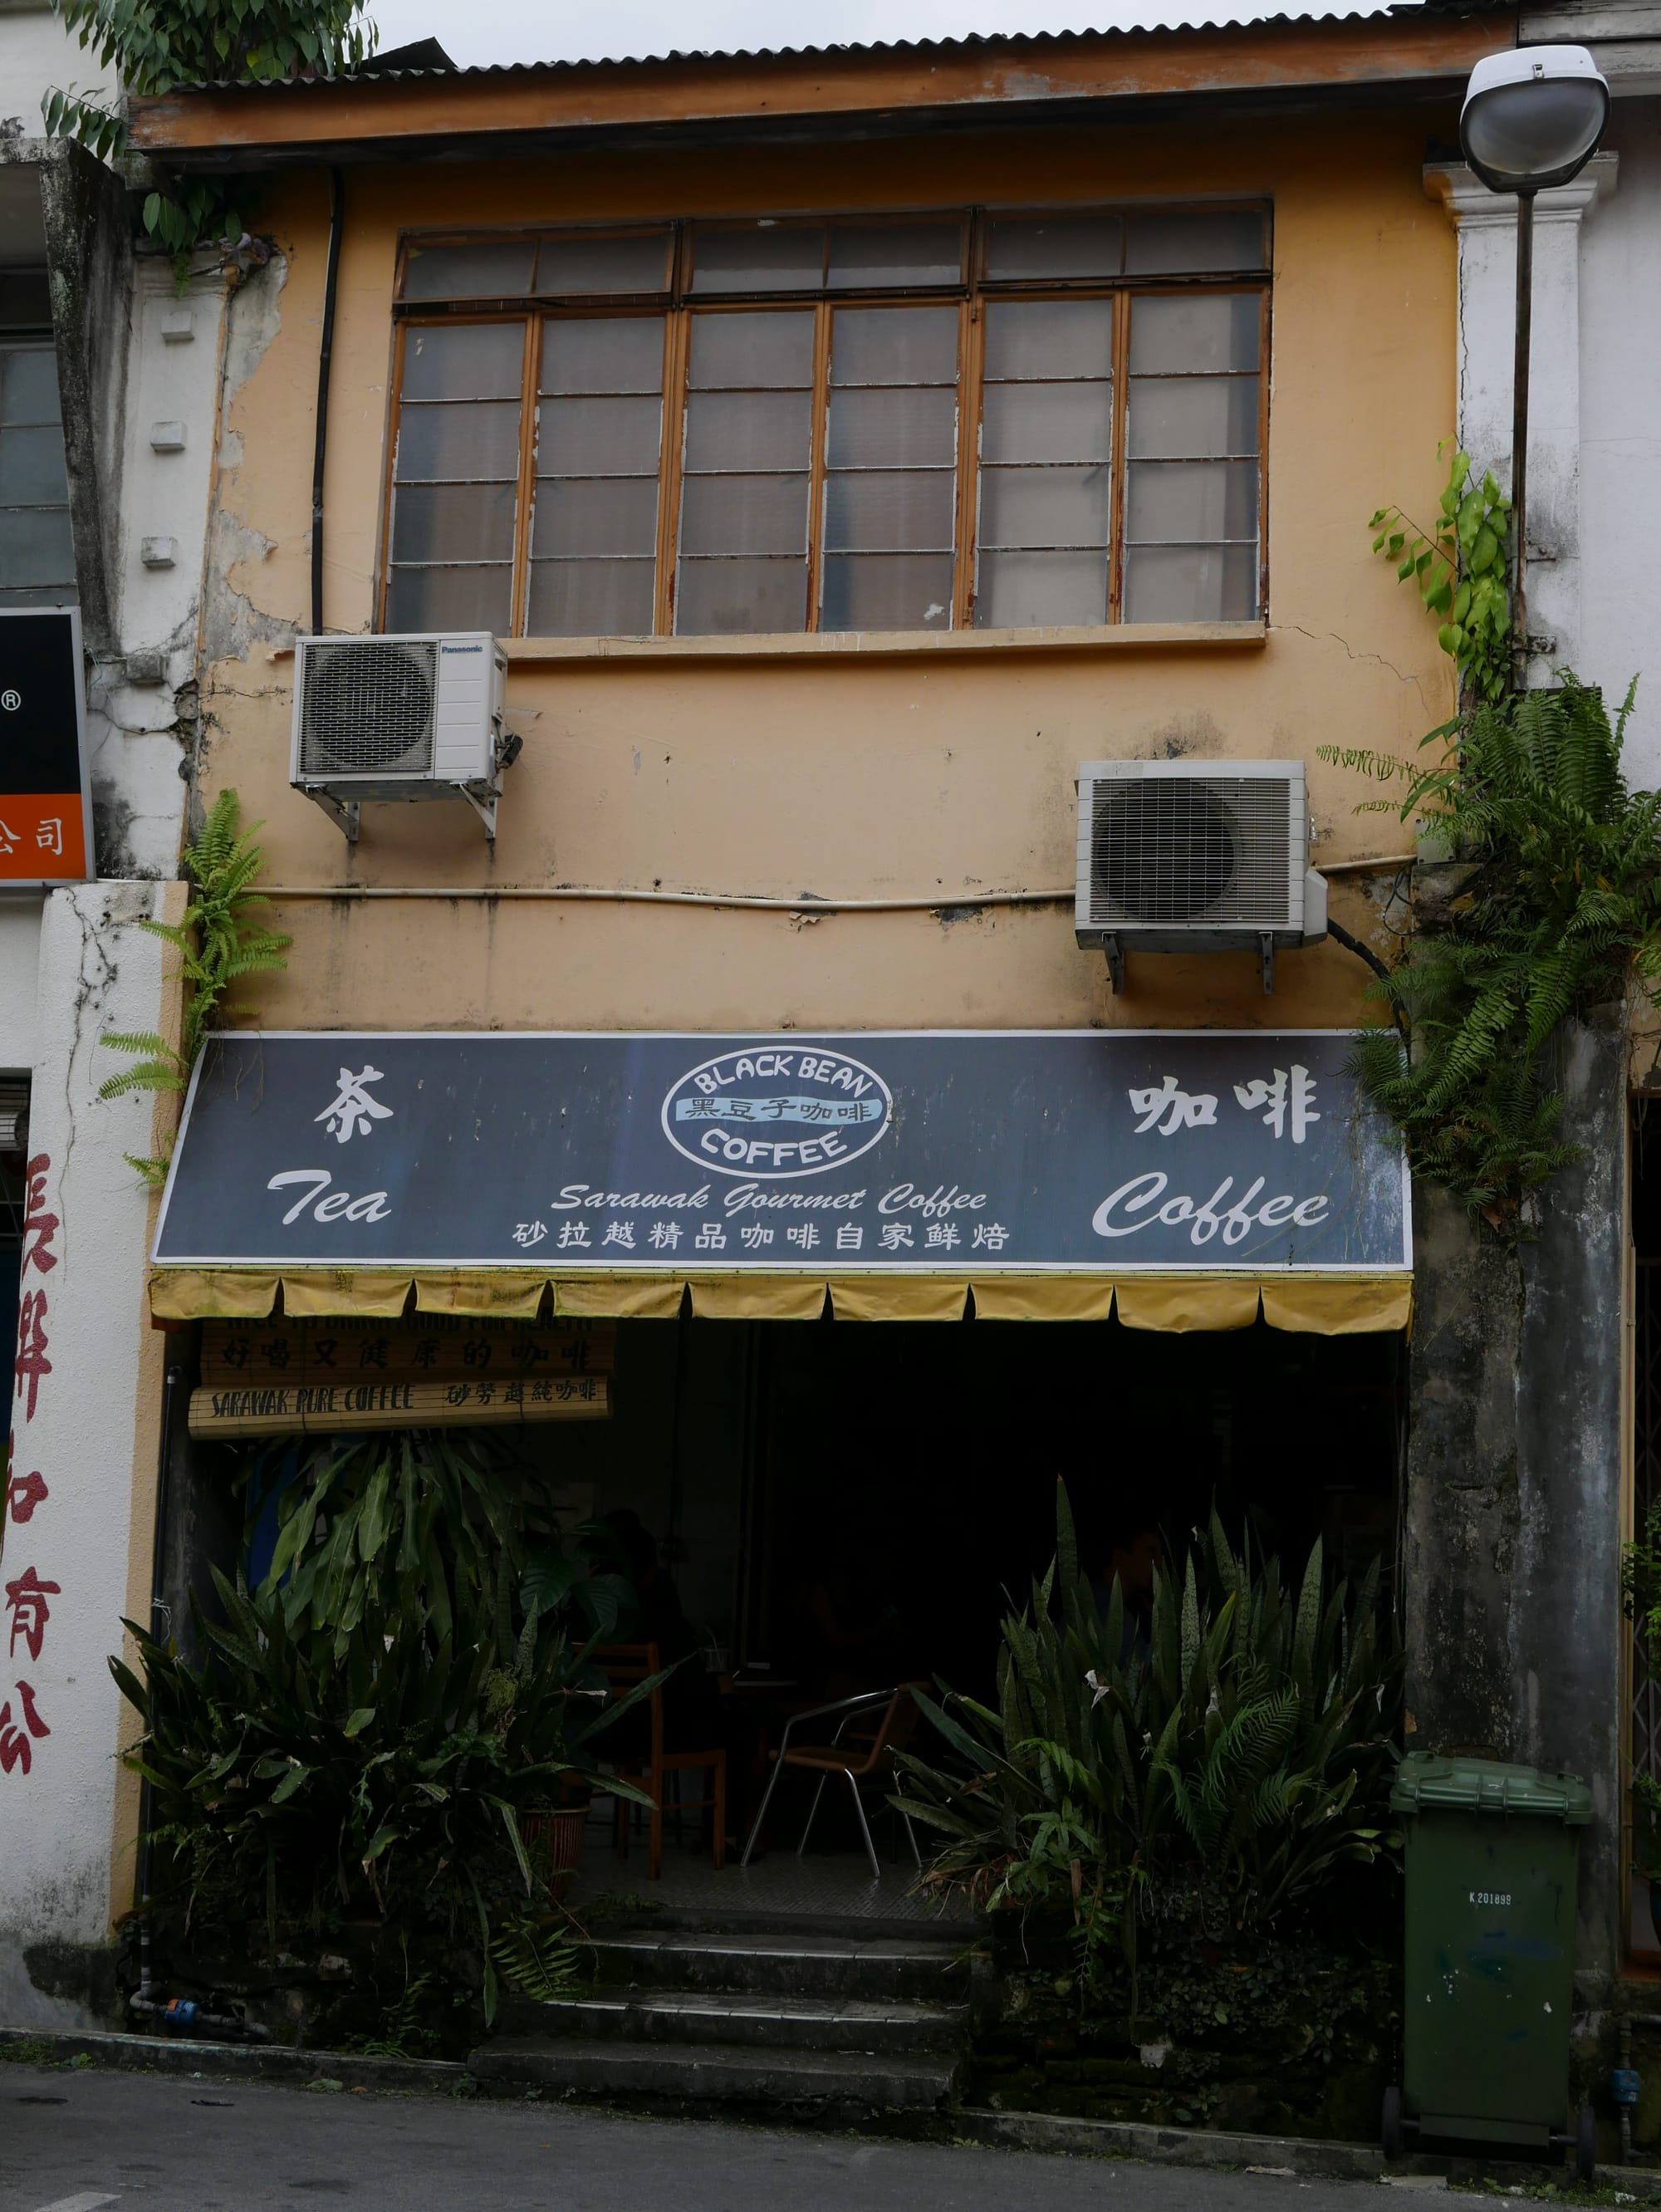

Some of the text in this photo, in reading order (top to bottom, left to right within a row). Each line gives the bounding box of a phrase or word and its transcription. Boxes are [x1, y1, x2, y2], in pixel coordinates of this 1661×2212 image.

[441, 645, 483, 654] Panasonic
[693, 1055, 873, 1098] BLACK BEAN
[313, 1064, 394, 1144] 茶
[684, 1098, 873, 1121] 黑豆子咖啡
[1128, 1064, 1321, 1144] 咖啡
[700, 1127, 848, 1166] COFFEE
[267, 1169, 393, 1225] Tea
[551, 1183, 987, 1219] Sarawak Gourmet Coffee
[1091, 1171, 1330, 1246] Coffee
[511, 1220, 1011, 1251] 砂拉越精品咖啡自家鲜焙
[211, 1382, 414, 1418] SARAWAK PURE COFFEE
